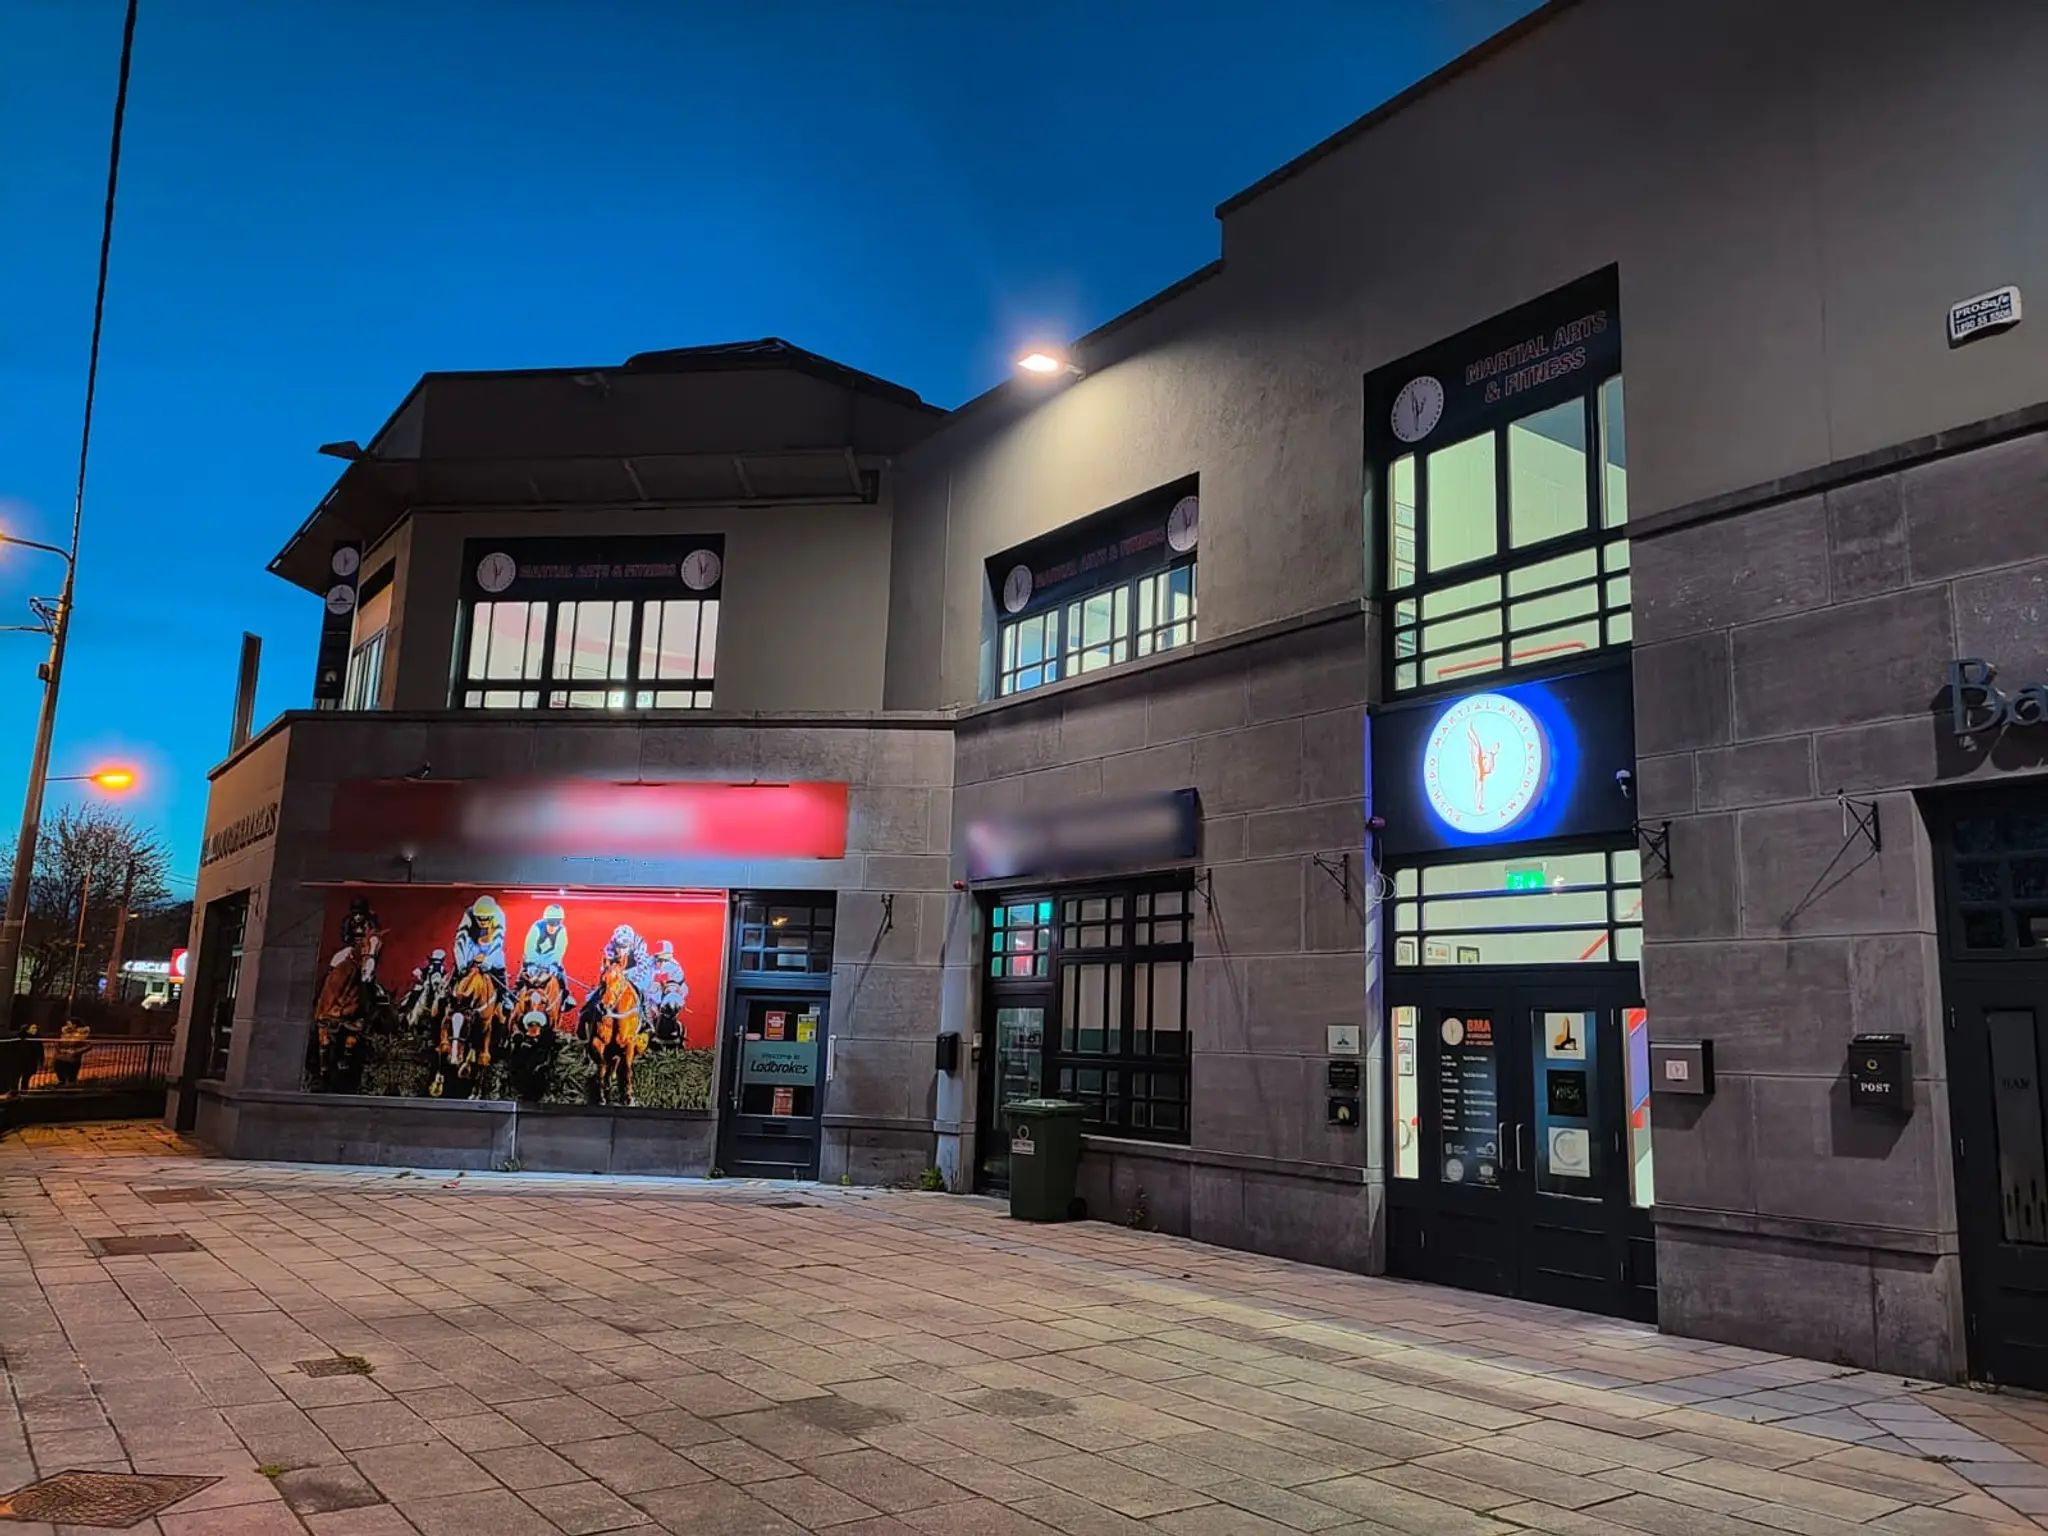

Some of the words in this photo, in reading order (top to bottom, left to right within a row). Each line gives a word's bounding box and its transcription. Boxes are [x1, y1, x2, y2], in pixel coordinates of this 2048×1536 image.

[1465, 334, 1550, 386] MARTIAL
[1552, 309, 1608, 352] ARTS
[1484, 380, 1501, 404] &
[1504, 346, 1587, 396] FITNESS
[1434, 700, 1491, 748] MARTIAL
[1498, 704, 1529, 733] ARTS
[1499, 742, 1536, 819] ACADEMY
[750, 1059, 809, 1075] Ladbrokes
[1859, 1081, 1891, 1093] POST
